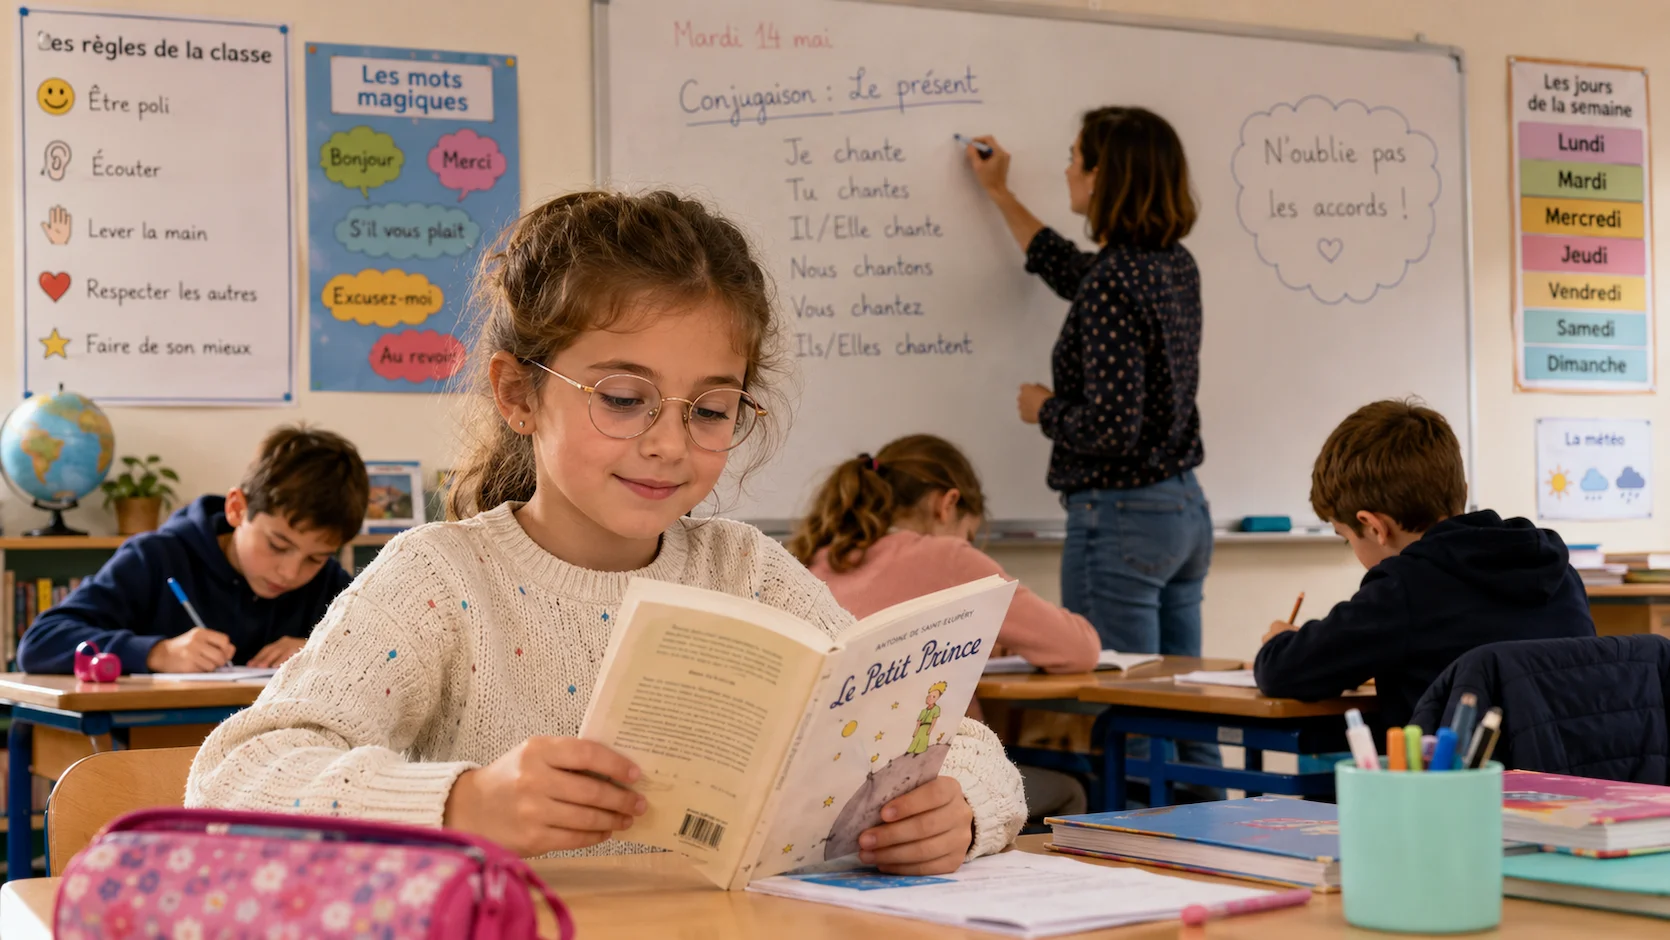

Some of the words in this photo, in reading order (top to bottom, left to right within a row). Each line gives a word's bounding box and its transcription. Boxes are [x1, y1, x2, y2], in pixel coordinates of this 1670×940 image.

[38, 31, 75, 52] es
[82, 34, 147, 61] règles
[153, 39, 179, 59] de
[186, 40, 204, 60] la
[209, 42, 272, 64] classe
[673, 20, 743, 49] Mardi
[754, 21, 782, 50] 14
[793, 26, 833, 49] mai
[362, 64, 400, 86] Les
[408, 70, 462, 90] mots
[1544, 73, 1570, 92] Les
[1573, 75, 1613, 98] jours
[88, 84, 130, 113] Être
[137, 96, 170, 121] poli
[356, 88, 468, 116] magiques
[679, 78, 818, 128] Conjugaison
[848, 66, 882, 101] Le
[895, 65, 981, 114] présent
[1527, 94, 1548, 112] de
[1551, 95, 1566, 114] la
[1570, 101, 1633, 118] semaine
[783, 137, 813, 166] Je
[833, 137, 906, 164] chante
[1264, 135, 1358, 166] N'oublie
[1372, 147, 1407, 175] pas
[1558, 132, 1605, 153] Lundi
[92, 149, 161, 178] Écouter
[329, 146, 395, 174] Bonjour
[442, 149, 492, 170] Merci
[785, 177, 818, 202] Tu
[837, 176, 911, 200] chantes
[1558, 170, 1607, 190] Mardi
[1269, 189, 1299, 219] les
[1313, 191, 1388, 218] accords
[1544, 205, 1621, 228] Mercredi
[88, 218, 135, 240] Lever
[142, 221, 158, 240] la
[164, 225, 208, 241] main
[348, 217, 378, 239] S'il
[383, 224, 421, 239] vous
[789, 213, 872, 242] Il/Elle
[884, 215, 944, 239] chante
[790, 255, 838, 280] Nous
[853, 254, 934, 278] chantons
[1561, 244, 1608, 265] Jeudi
[86, 278, 171, 307] Respecter
[178, 281, 201, 302] les
[207, 284, 258, 303] autres
[333, 286, 433, 307] Excusez-moi
[1547, 281, 1622, 302] Vendredi
[790, 296, 836, 319] Vous
[851, 294, 925, 317] chantez
[1556, 318, 1615, 338] Samedi
[86, 333, 131, 355] Faire
[138, 334, 159, 355] de
[165, 342, 196, 356] son
[202, 338, 251, 356] mieux
[379, 345, 404, 365] Au
[896, 332, 974, 356] chantent
[1546, 353, 1627, 374] Dimanche
[1565, 432, 1581, 447] La
[909, 628, 920, 638] DE
[829, 674, 856, 710] Le
[860, 654, 912, 696] Petit
[915, 637, 983, 675] Prince
